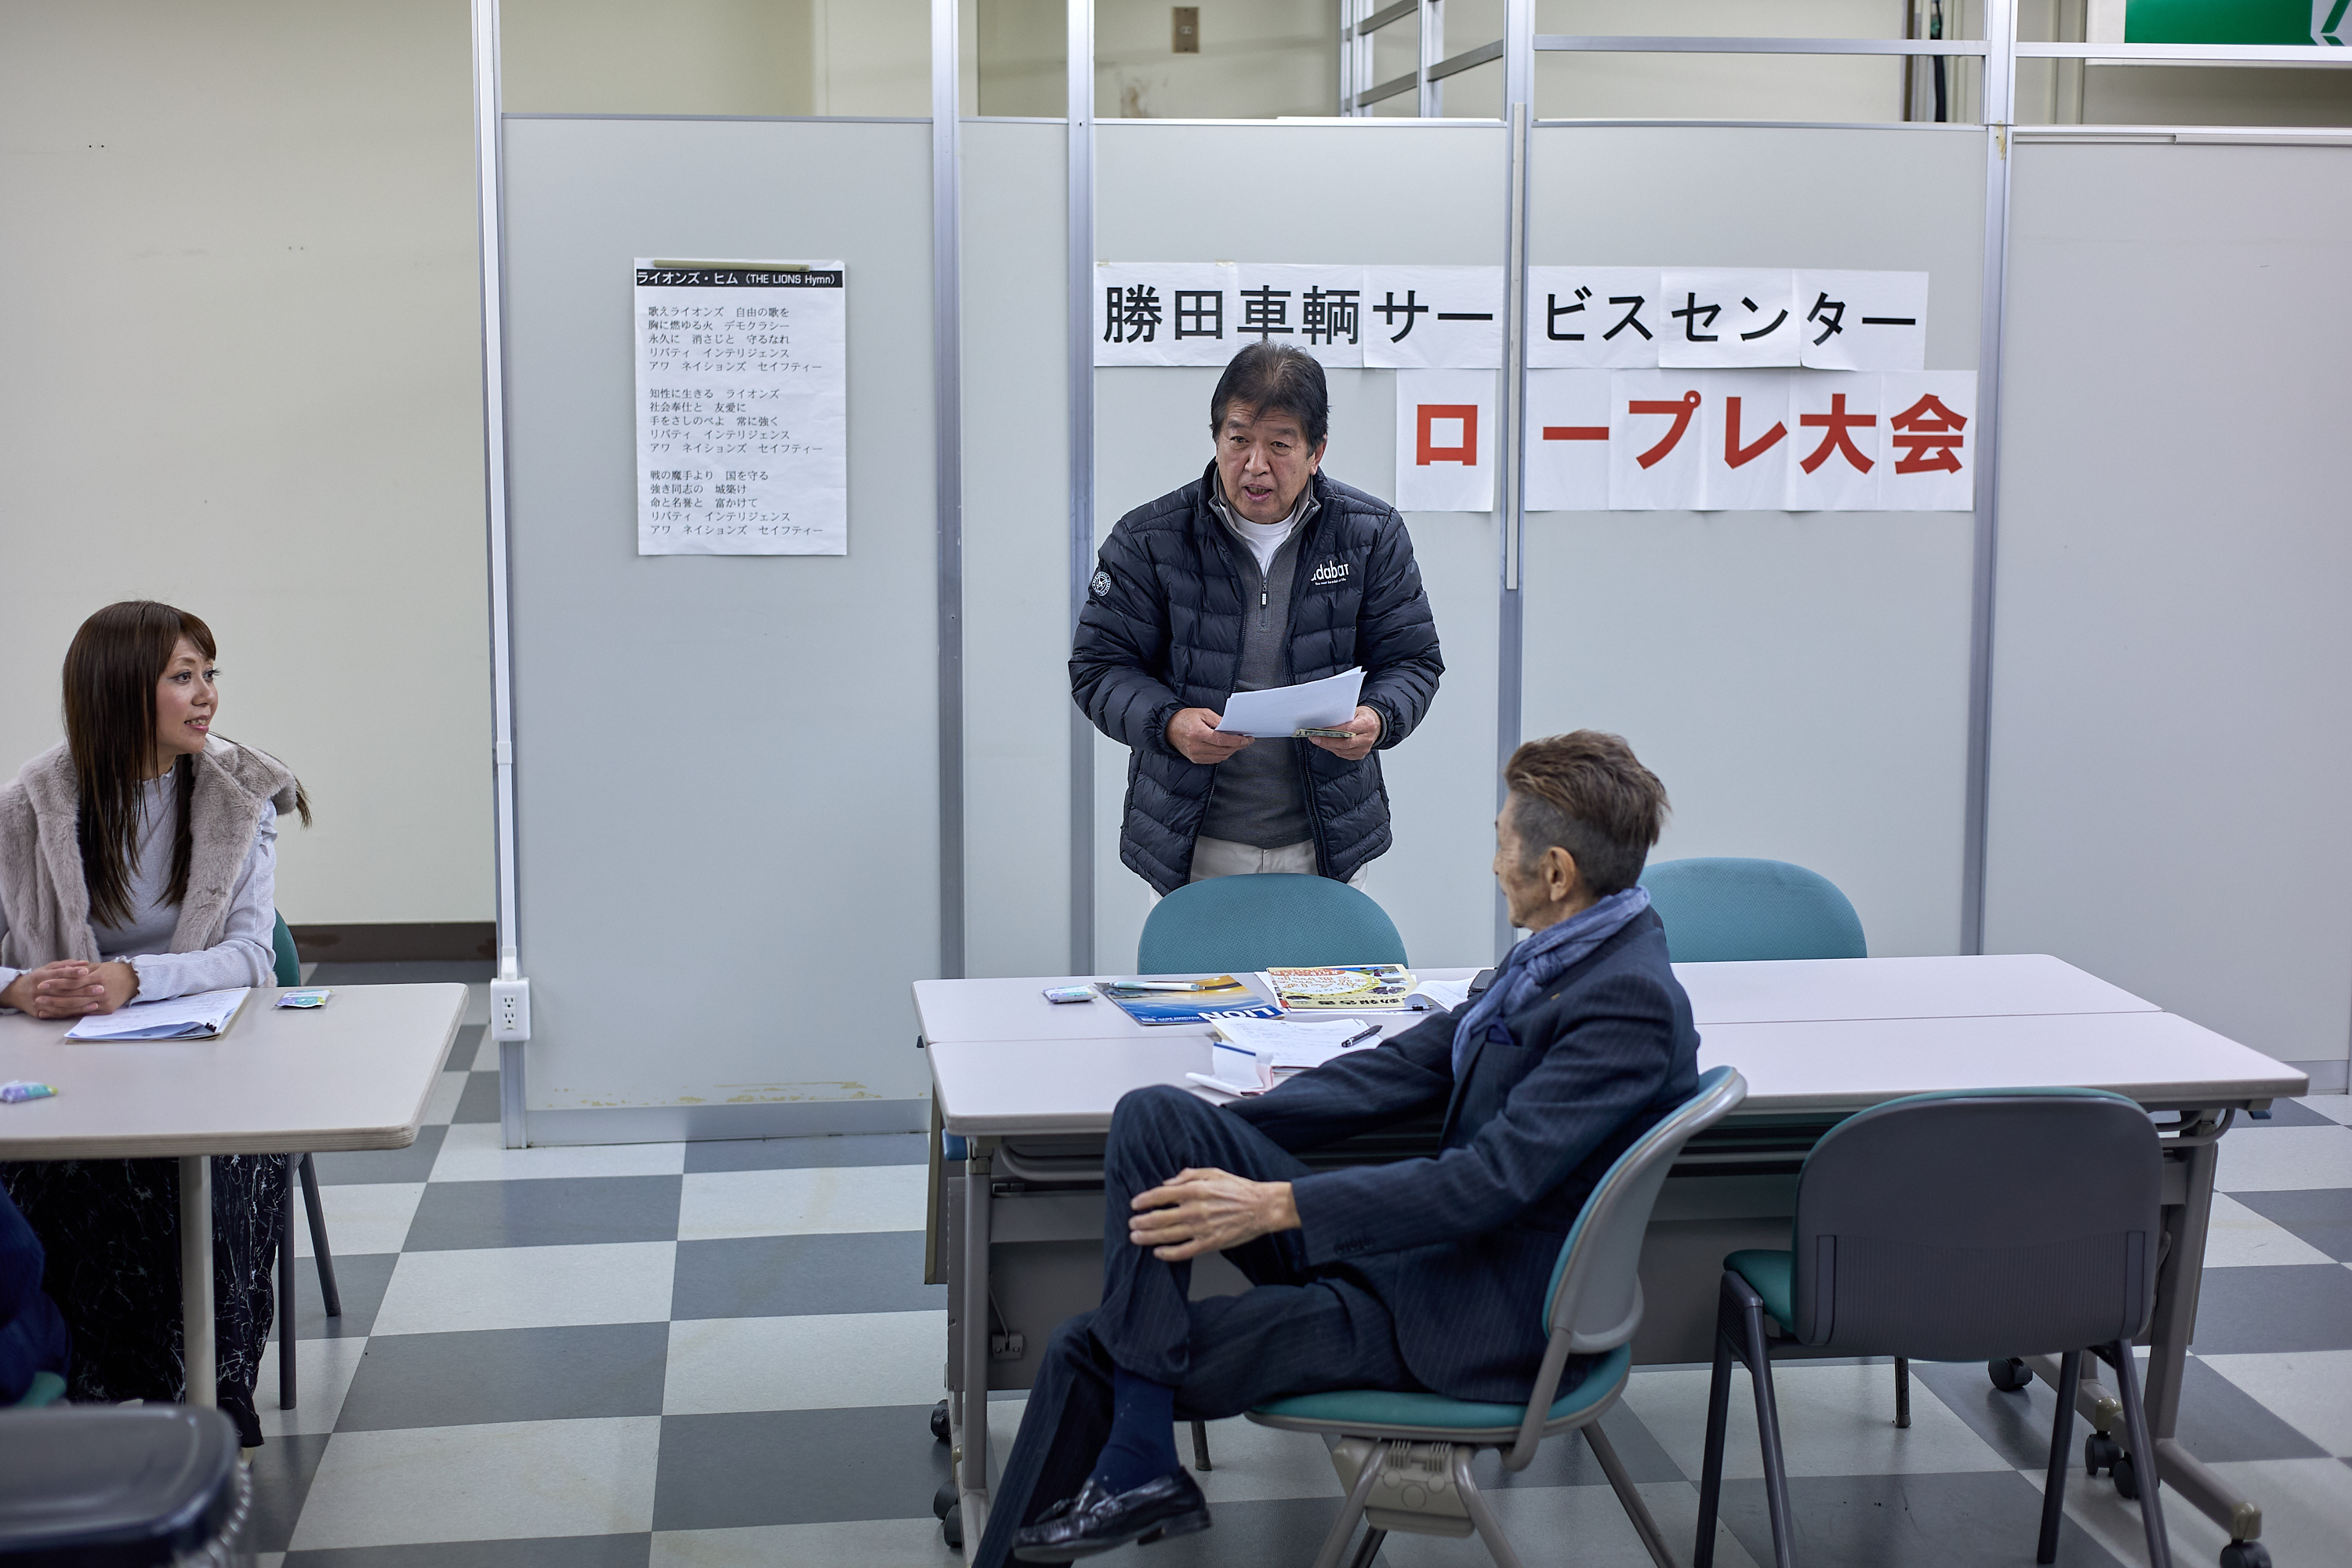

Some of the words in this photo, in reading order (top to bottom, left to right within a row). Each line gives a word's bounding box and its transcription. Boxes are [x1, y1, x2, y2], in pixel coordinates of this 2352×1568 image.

[637, 272, 739, 285] ライオンズ・ヒム
[773, 274, 801, 285] LIONS
[648, 307, 724, 318] 歌えライオンズ
[736, 307, 789, 318] 自由の歌を
[648, 320, 713, 331] 胸に燃ゆる火
[724, 321, 789, 331] デモクラシー
[648, 334, 681, 344] 永久に
[692, 334, 735, 344] 消さじと
[747, 334, 790, 344] 守るなれ
[650, 348, 690, 358] リバティ
[703, 348, 789, 358] インテリジェンス
[649, 361, 670, 371] アワ
[681, 361, 746, 372] ネイションズ
[757, 361, 822, 372] セイフティー
[649, 388, 713, 399] 知性に生きる
[726, 389, 779, 399] ライオンズ
[649, 402, 702, 412] 社会奉仕と
[714, 402, 746, 412] 友愛に
[650, 416, 724, 426] 手をさしのべよ
[736, 416, 779, 426] 常に強く
[651, 430, 690, 440] リバティ
[704, 430, 790, 440] インテリジェンス
[1417, 390, 1968, 474] ロープレ大会
[650, 443, 670, 453] アワ
[682, 443, 747, 454] ネイションズ
[758, 444, 822, 454] セイフティー
[650, 470, 713, 481] 戦の魔手より
[725, 470, 768, 481] 国を守る
[650, 484, 704, 494] 強き同志の
[714, 484, 747, 494] 城築け
[650, 497, 703, 508] 命と名誉と
[715, 498, 758, 508] 富かけて
[652, 511, 691, 521] リバティ
[705, 511, 790, 522] インテリジェンス
[651, 524, 670, 535] アワ
[683, 524, 747, 535] ネイションズ
[758, 525, 822, 536] セイフティー
